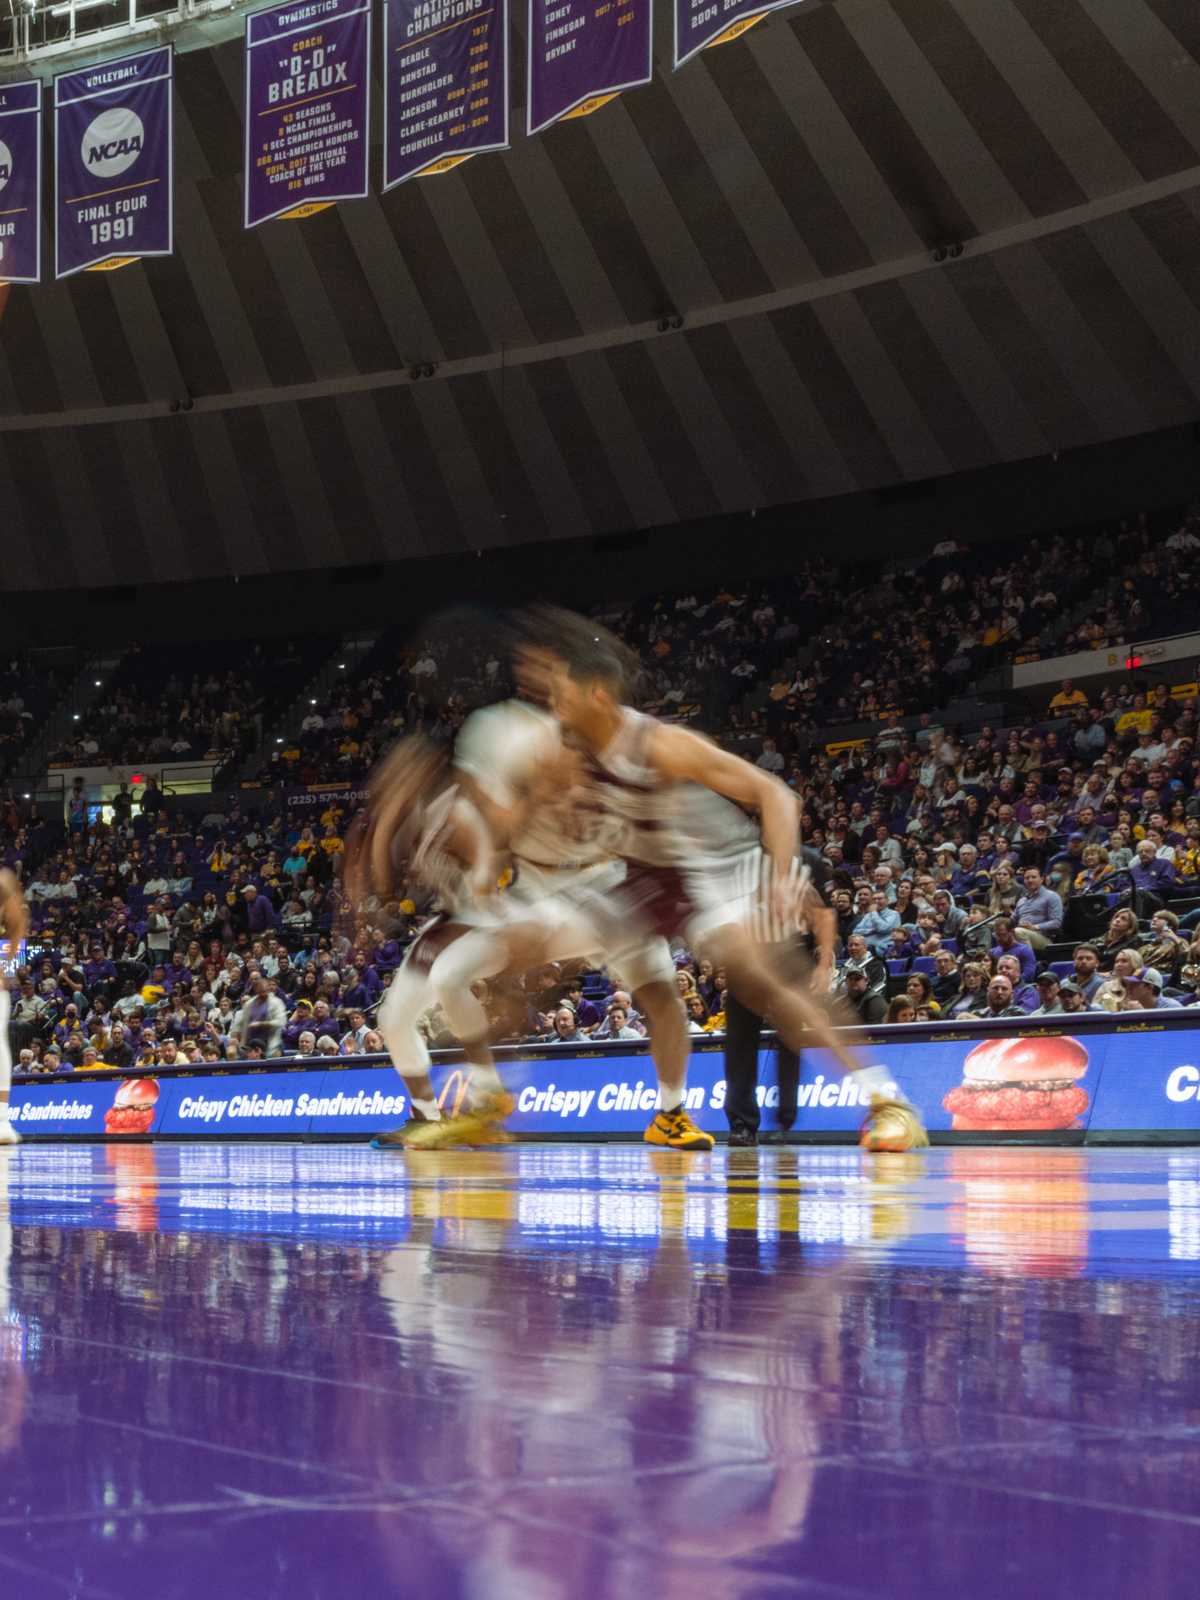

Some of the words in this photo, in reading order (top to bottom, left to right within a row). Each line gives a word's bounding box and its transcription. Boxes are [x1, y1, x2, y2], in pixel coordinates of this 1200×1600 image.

[278, 0, 338, 26] GYMNASTICS
[406, 0, 483, 37] CHAMPIONS
[413, 0, 458, 20] NATIO
[545, 4, 571, 24] EDNEY
[691, 4, 718, 29] 2004
[545, 16, 585, 44] FINNEGAN
[292, 35, 323, 52] COACH
[545, 39, 576, 62] BRYANT
[401, 47, 431, 68] BEADLE
[86, 65, 139, 88] VOLLEYBALL
[268, 62, 347, 103] BREAUX
[401, 73, 454, 103] BURKHOLDER
[295, 102, 332, 120] SEASONS
[400, 98, 438, 121] JACKSON
[400, 105, 465, 138] CLARE-KEARNEY
[270, 139, 285, 151] SEC
[287, 119, 353, 145] CHAMPIONSHIPS
[286, 121, 307, 134] NCAA
[308, 112, 336, 128] FINALS
[88, 135, 141, 165] NCAA
[274, 140, 324, 162] ALL-AMERICA
[325, 130, 359, 147] HONORS
[309, 146, 347, 163] NATIONAL
[400, 131, 444, 156] COURVILLE
[269, 170, 295, 184] COACH
[297, 167, 307, 177] OF
[309, 161, 324, 173] THE
[325, 156, 347, 169] YEAR
[304, 173, 326, 186] WINS
[77, 205, 112, 224] FINAL
[115, 195, 148, 216] FOUR
[90, 216, 134, 245] 1991
[20, 1100, 93, 1121] Sandwiches
[179, 1096, 228, 1122] Crispy
[228, 1093, 293, 1118] Chicken
[295, 1090, 406, 1116] Sandwiches
[518, 1084, 595, 1117] Crispy
[598, 1081, 705, 1111] Chicn
